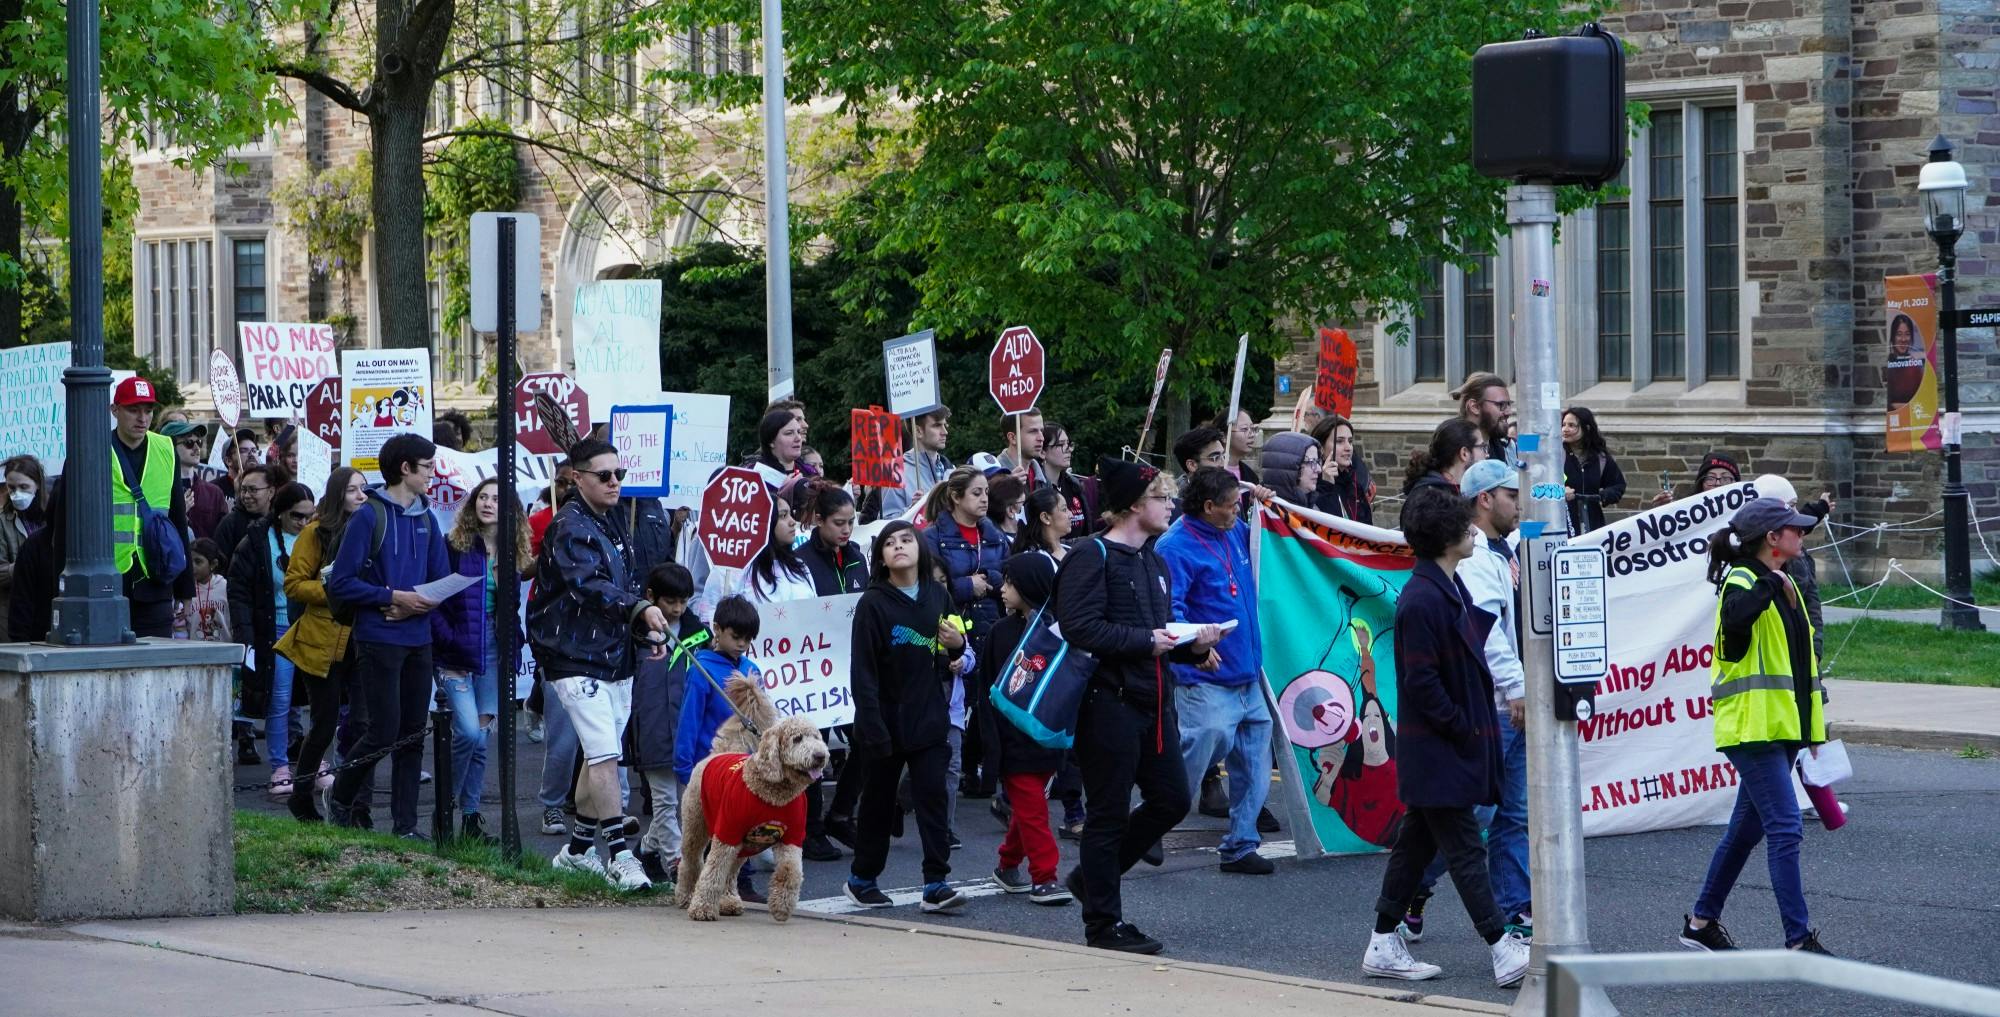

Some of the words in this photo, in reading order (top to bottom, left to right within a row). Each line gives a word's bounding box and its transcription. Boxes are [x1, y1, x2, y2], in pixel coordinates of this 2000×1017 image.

[1887, 300, 1903, 310] May
[1912, 298, 1929, 308] 2023
[1970, 312, 2000, 324] SHAPIR
[244, 325, 280, 353] NO
[289, 326, 337, 353] MAS
[592, 319, 623, 345] AL
[1002, 333, 1031, 363] ALTO
[254, 354, 330, 382] FONDO
[356, 360, 371, 368] ALL
[371, 359, 387, 368] OUT
[388, 359, 399, 367] ON
[400, 359, 415, 367] MAY
[1009, 362, 1023, 378] AL
[1887, 359, 1923, 369] Innovation
[248, 383, 289, 410] PARA
[523, 377, 576, 407] STOP
[614, 412, 631, 433] NO
[615, 435, 632, 452] TO
[638, 433, 660, 448] THE
[628, 470, 661, 485] THEFT!
[720, 477, 760, 504] STOP
[711, 508, 760, 535] WAGE
[1601, 530, 1632, 556] de
[1636, 483, 1759, 545] Nosotros
[708, 533, 751, 557] THEFT
[1606, 533, 1714, 578] osotro
[800, 632, 831, 655] AL
[763, 658, 833, 690] ODIO
[1579, 664, 1592, 672] CROSS
